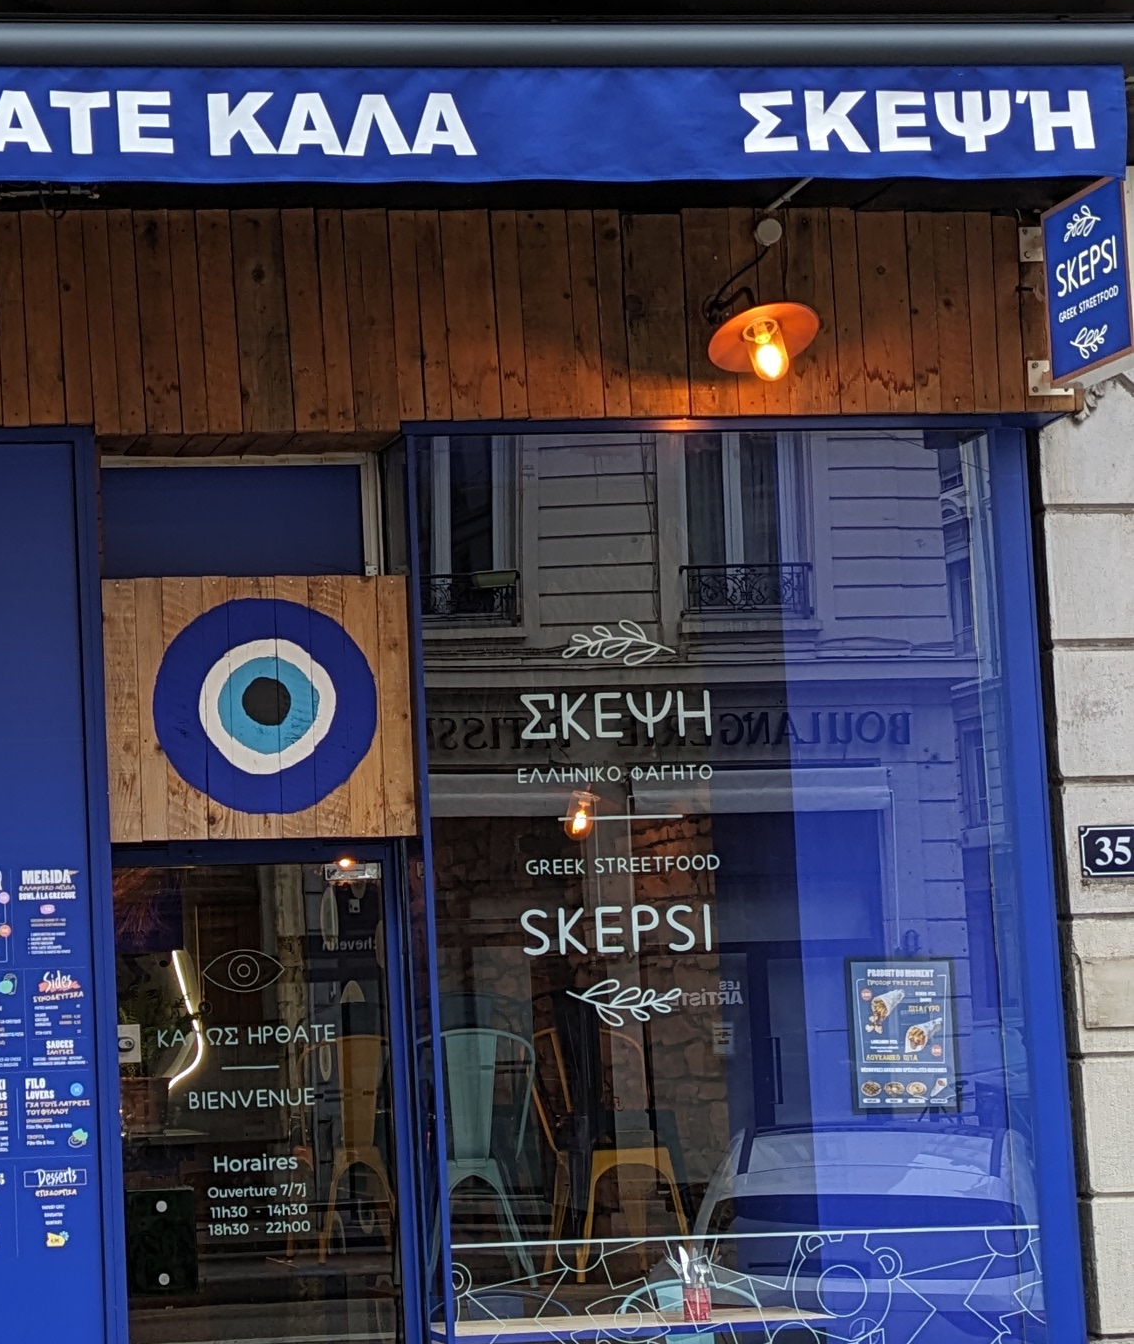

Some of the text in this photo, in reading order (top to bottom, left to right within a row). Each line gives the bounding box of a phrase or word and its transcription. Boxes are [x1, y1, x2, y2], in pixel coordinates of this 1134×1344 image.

[207, 91, 478, 157] ΚΑΛΑ
[1055, 235, 1118, 298] SKEPSI
[1058, 284, 1119, 323] GREEK STREETFOOD
[519, 689, 713, 741] ΣΚΕΨΗ
[517, 763, 714, 784] ΕΛΛΗΝΙΚΟ ΦΑΓΗΤΟ
[1094, 836, 1132, 866] 35
[525, 854, 721, 877] GREEK STREETFOOD
[21, 869, 72, 885] MERIDA
[519, 903, 713, 956] SKEPSI
[43, 969, 73, 993] Sides
[45, 1039, 75, 1050] SAUCES
[156, 1023, 337, 1049] ΚΑΩΣ ΗΡΘΑΤΕ
[24, 1077, 46, 1090] FILO
[25, 1089, 55, 1101] LOVERS
[188, 1087, 316, 1111] BIENVENUE
[212, 1152, 299, 1174] Horaires
[33, 1166, 78, 1188] Desserts
[207, 1181, 307, 1200] Ouverture 7/7j
[209, 1204, 248, 1219] 11h30
[266, 1202, 308, 1217] 14h30
[208, 1222, 250, 1237] 18h30
[265, 1220, 311, 1235] 22h00
